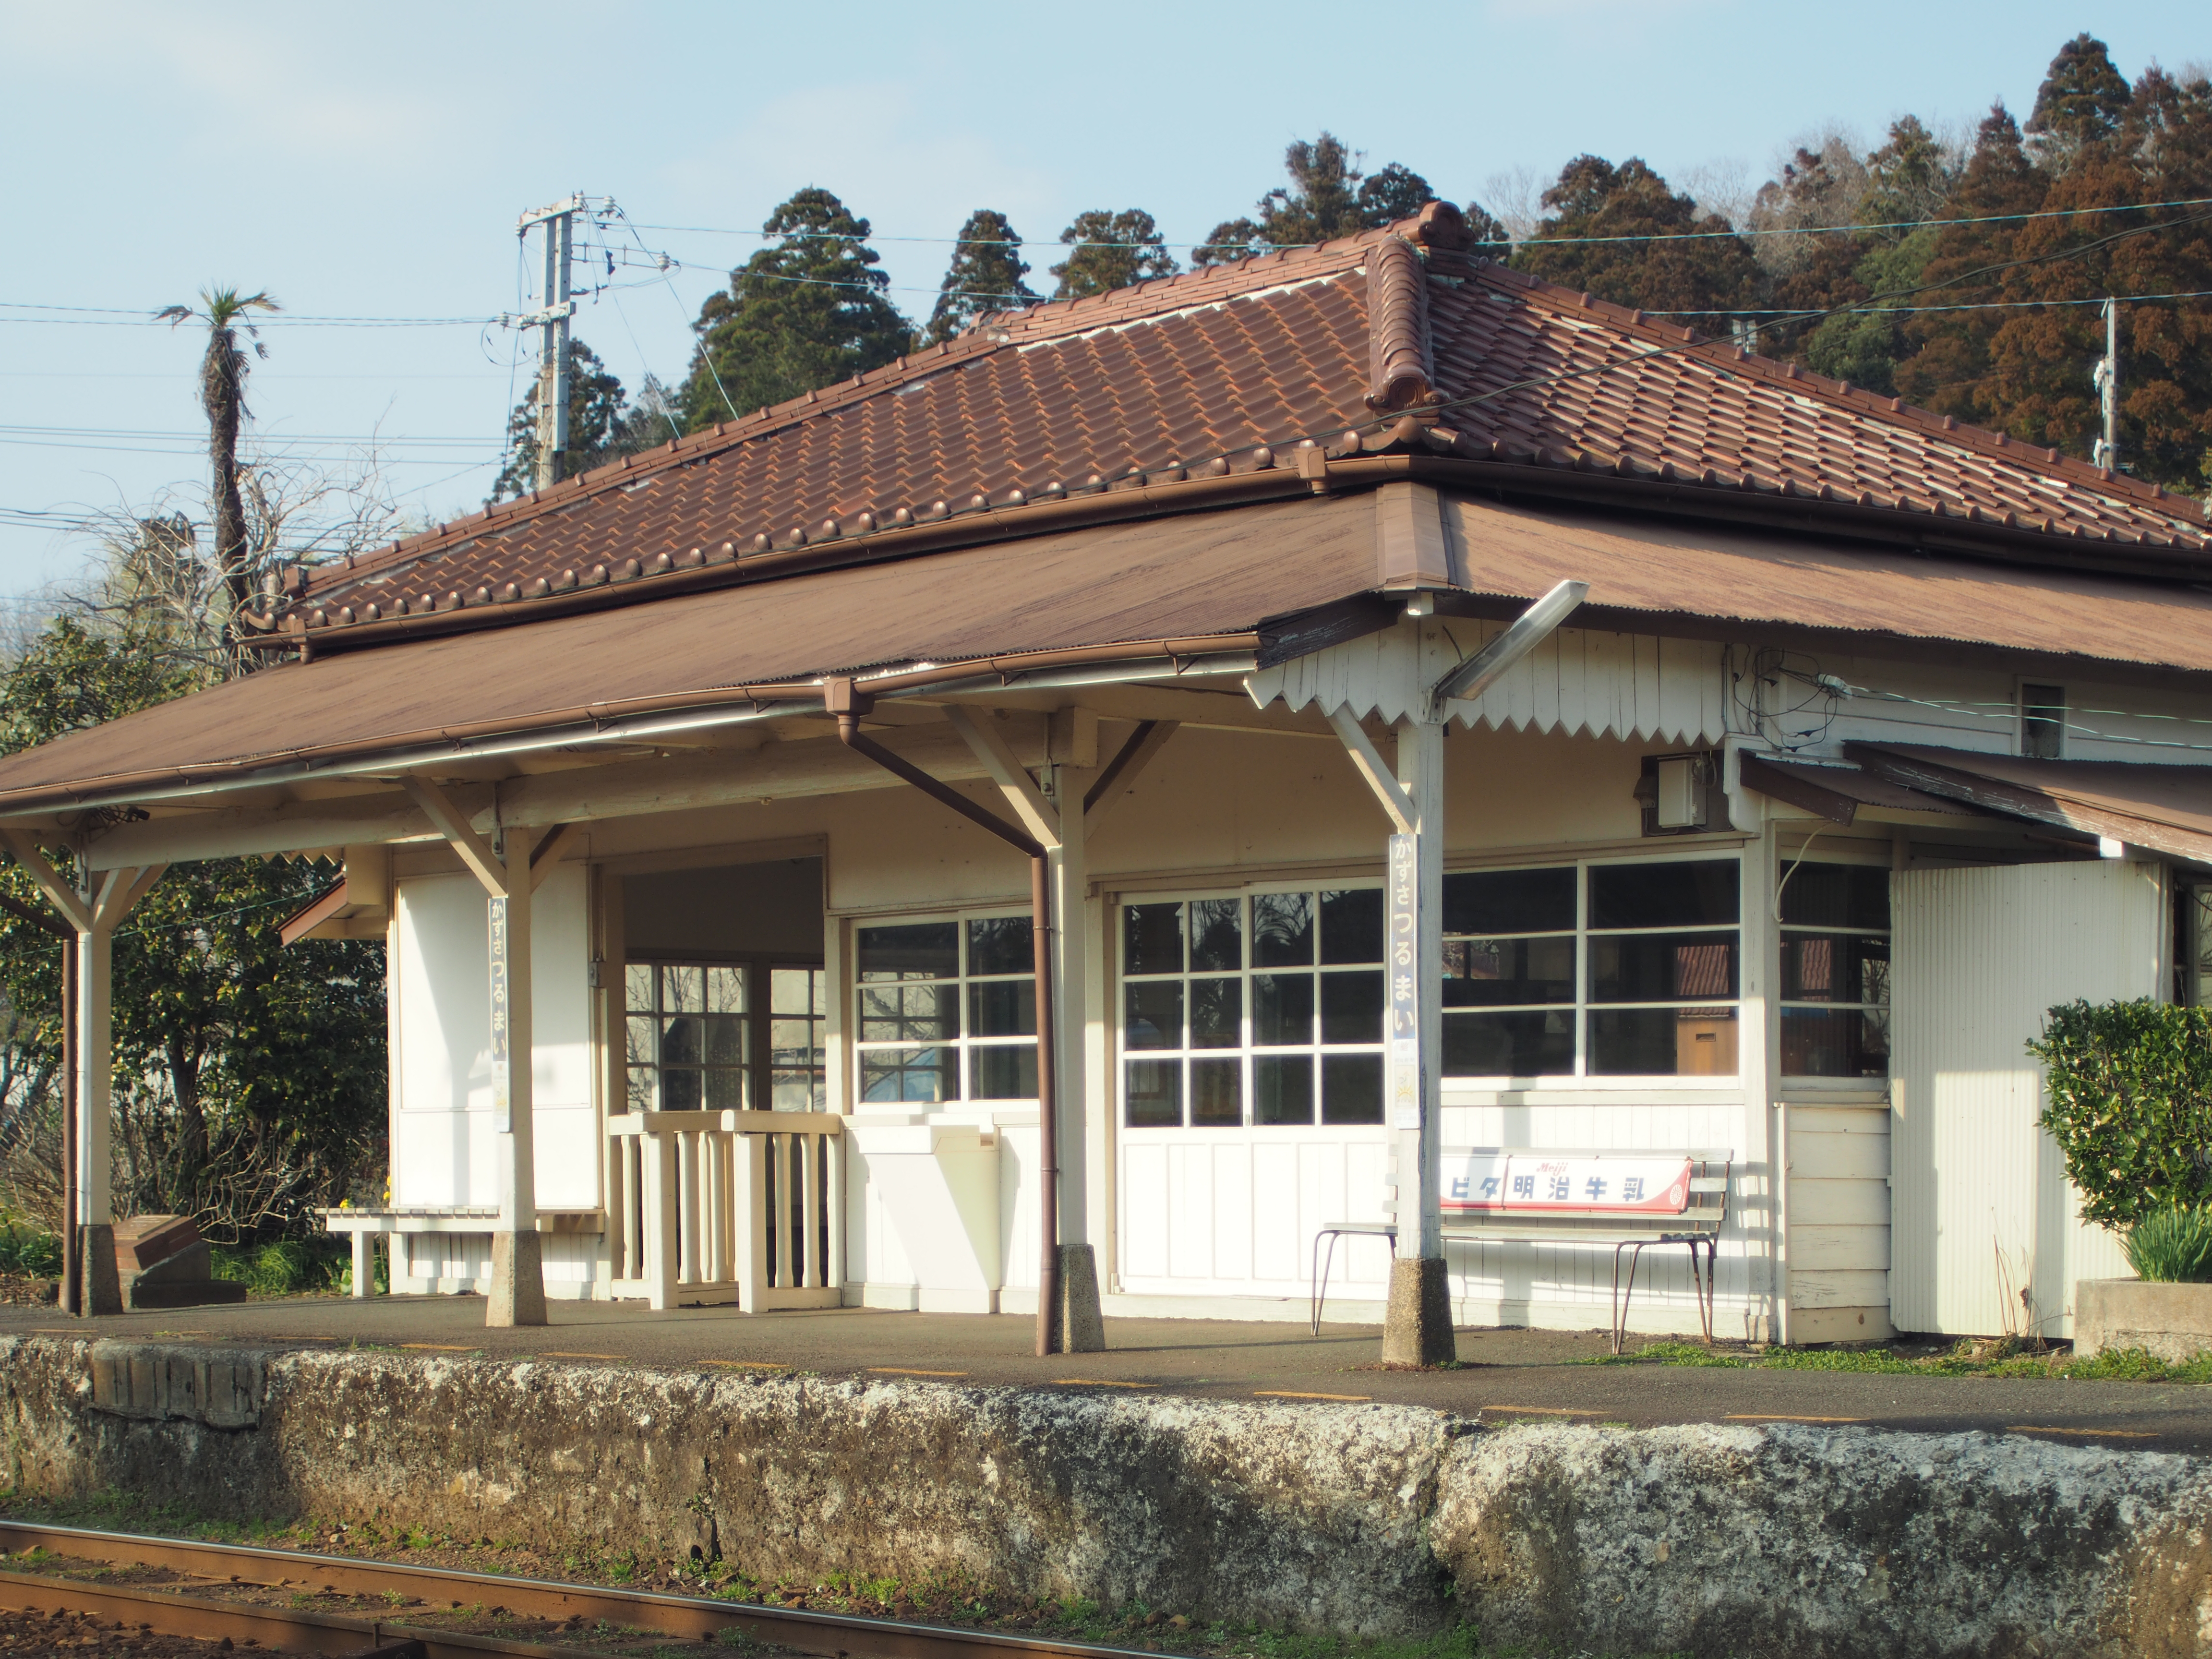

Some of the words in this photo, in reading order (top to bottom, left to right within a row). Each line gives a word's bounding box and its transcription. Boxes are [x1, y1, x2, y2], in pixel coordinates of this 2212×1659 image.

[492, 902, 506, 1055] かずさつるまい
[1394, 838, 1414, 1031] かずさつるまい
[1536, 1162, 1568, 1176] Meiji
